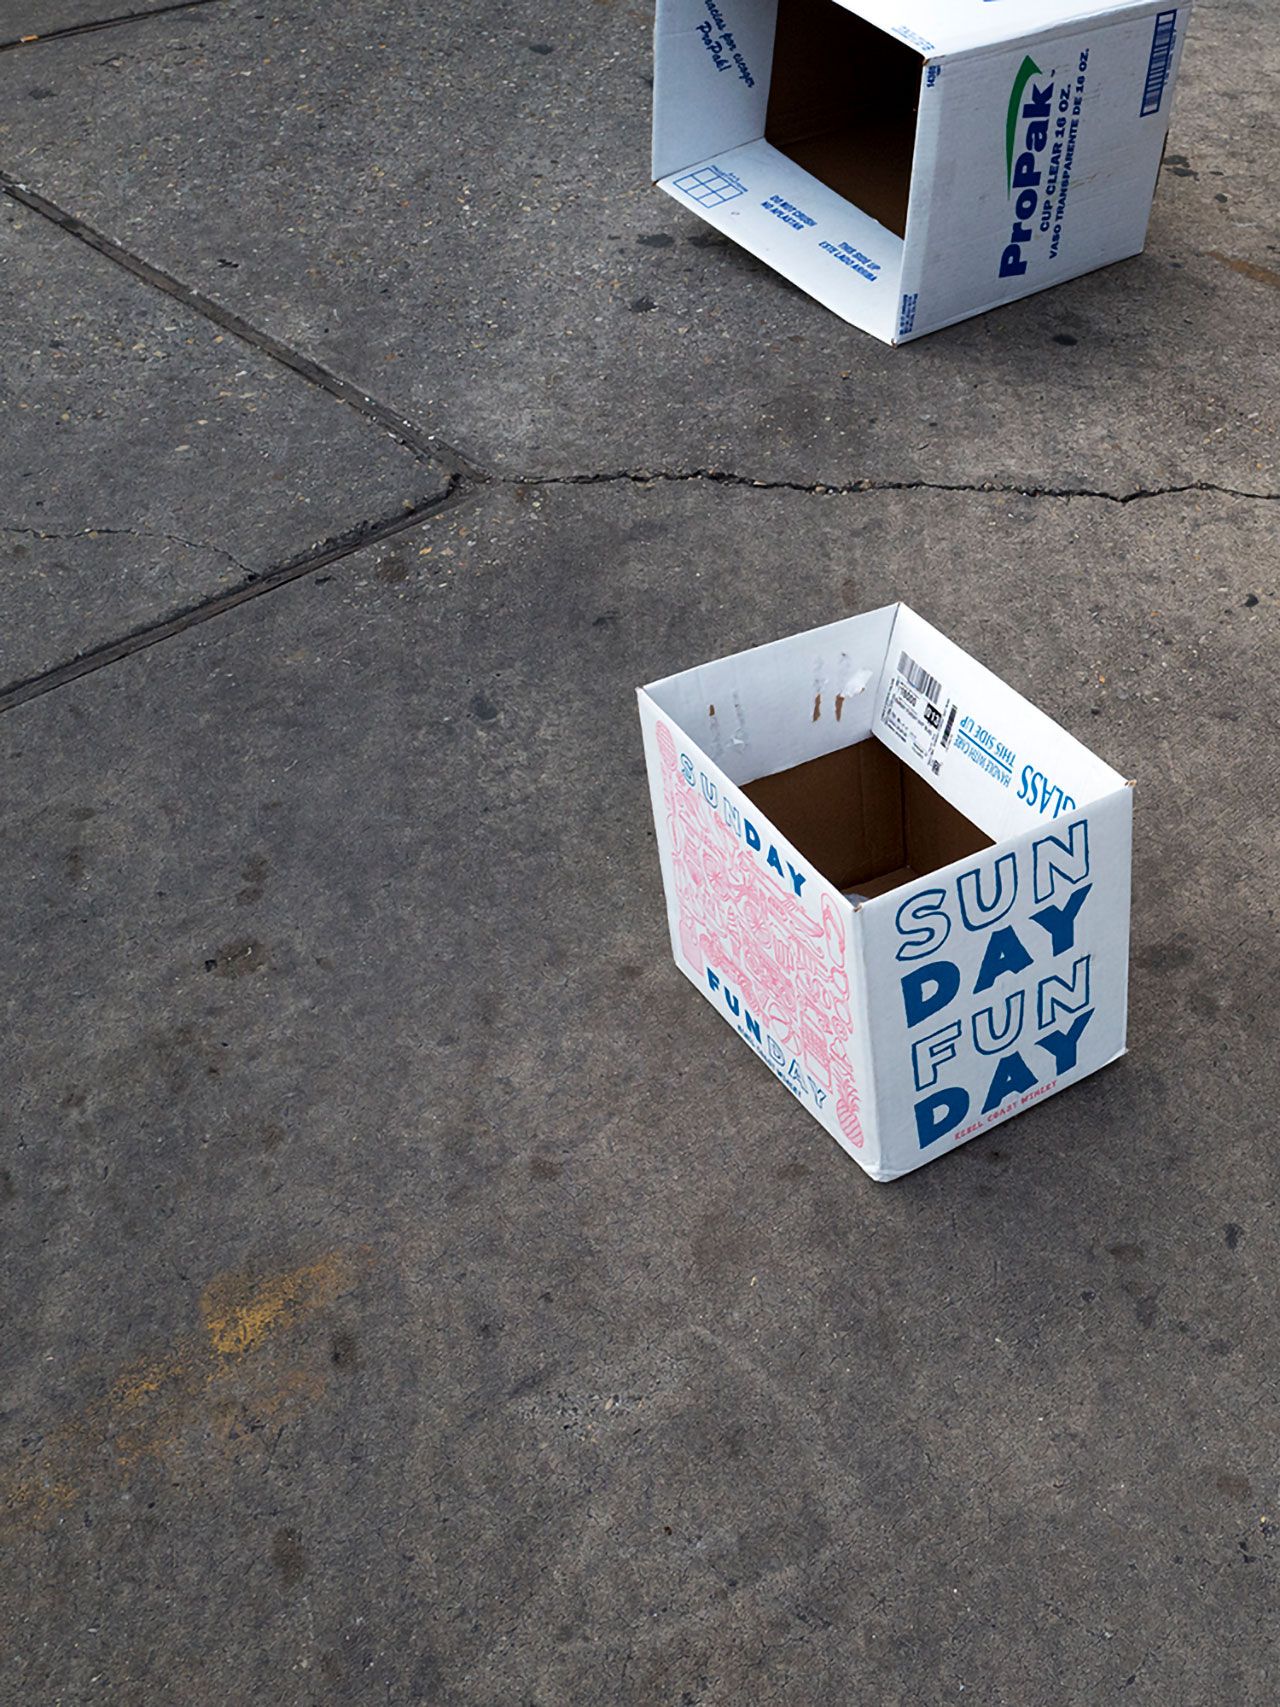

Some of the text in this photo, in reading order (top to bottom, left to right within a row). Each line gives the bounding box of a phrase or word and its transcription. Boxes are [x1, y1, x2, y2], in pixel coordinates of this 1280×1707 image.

[1055, 116, 1067, 138] 16
[1072, 96, 1083, 116] DE
[998, 82, 1055, 278] ProPak
[1046, 142, 1063, 196] CLEAR
[1055, 119, 1080, 222] TRANSPARENTE
[1040, 199, 1053, 232] CUP
[1049, 224, 1062, 260] VASO
[960, 716, 976, 733] UP
[974, 725, 998, 751] SIDE
[995, 742, 1017, 768] THIS
[895, 819, 1090, 962] SUN
[900, 882, 1094, 1029] DAY
[911, 953, 1091, 1093] FUN
[913, 1006, 1096, 1150] DAY
